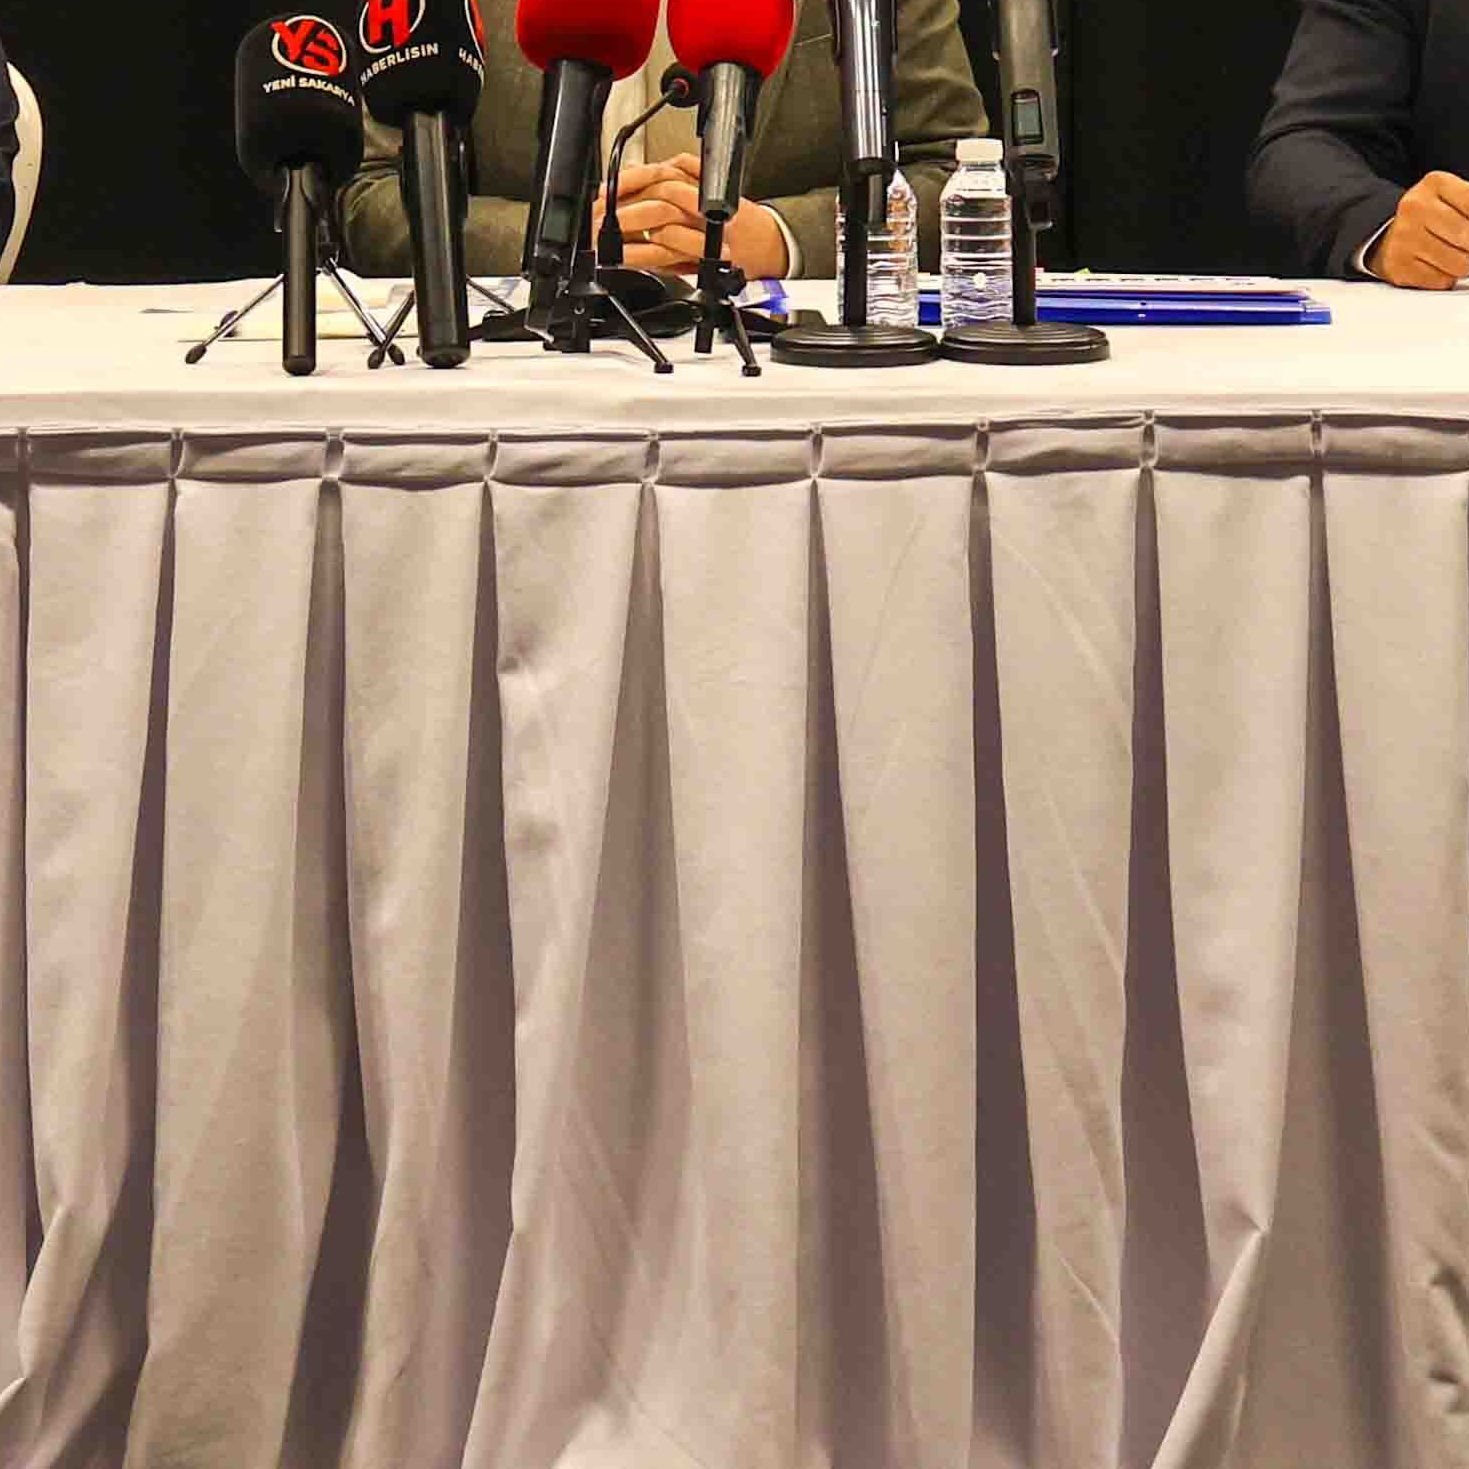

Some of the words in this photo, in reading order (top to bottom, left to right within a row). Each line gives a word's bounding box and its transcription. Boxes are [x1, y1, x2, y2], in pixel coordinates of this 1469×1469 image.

[270, 20, 340, 77] YS
[262, 74, 297, 94] YENİ
[298, 76, 356, 107] SAKARYA
